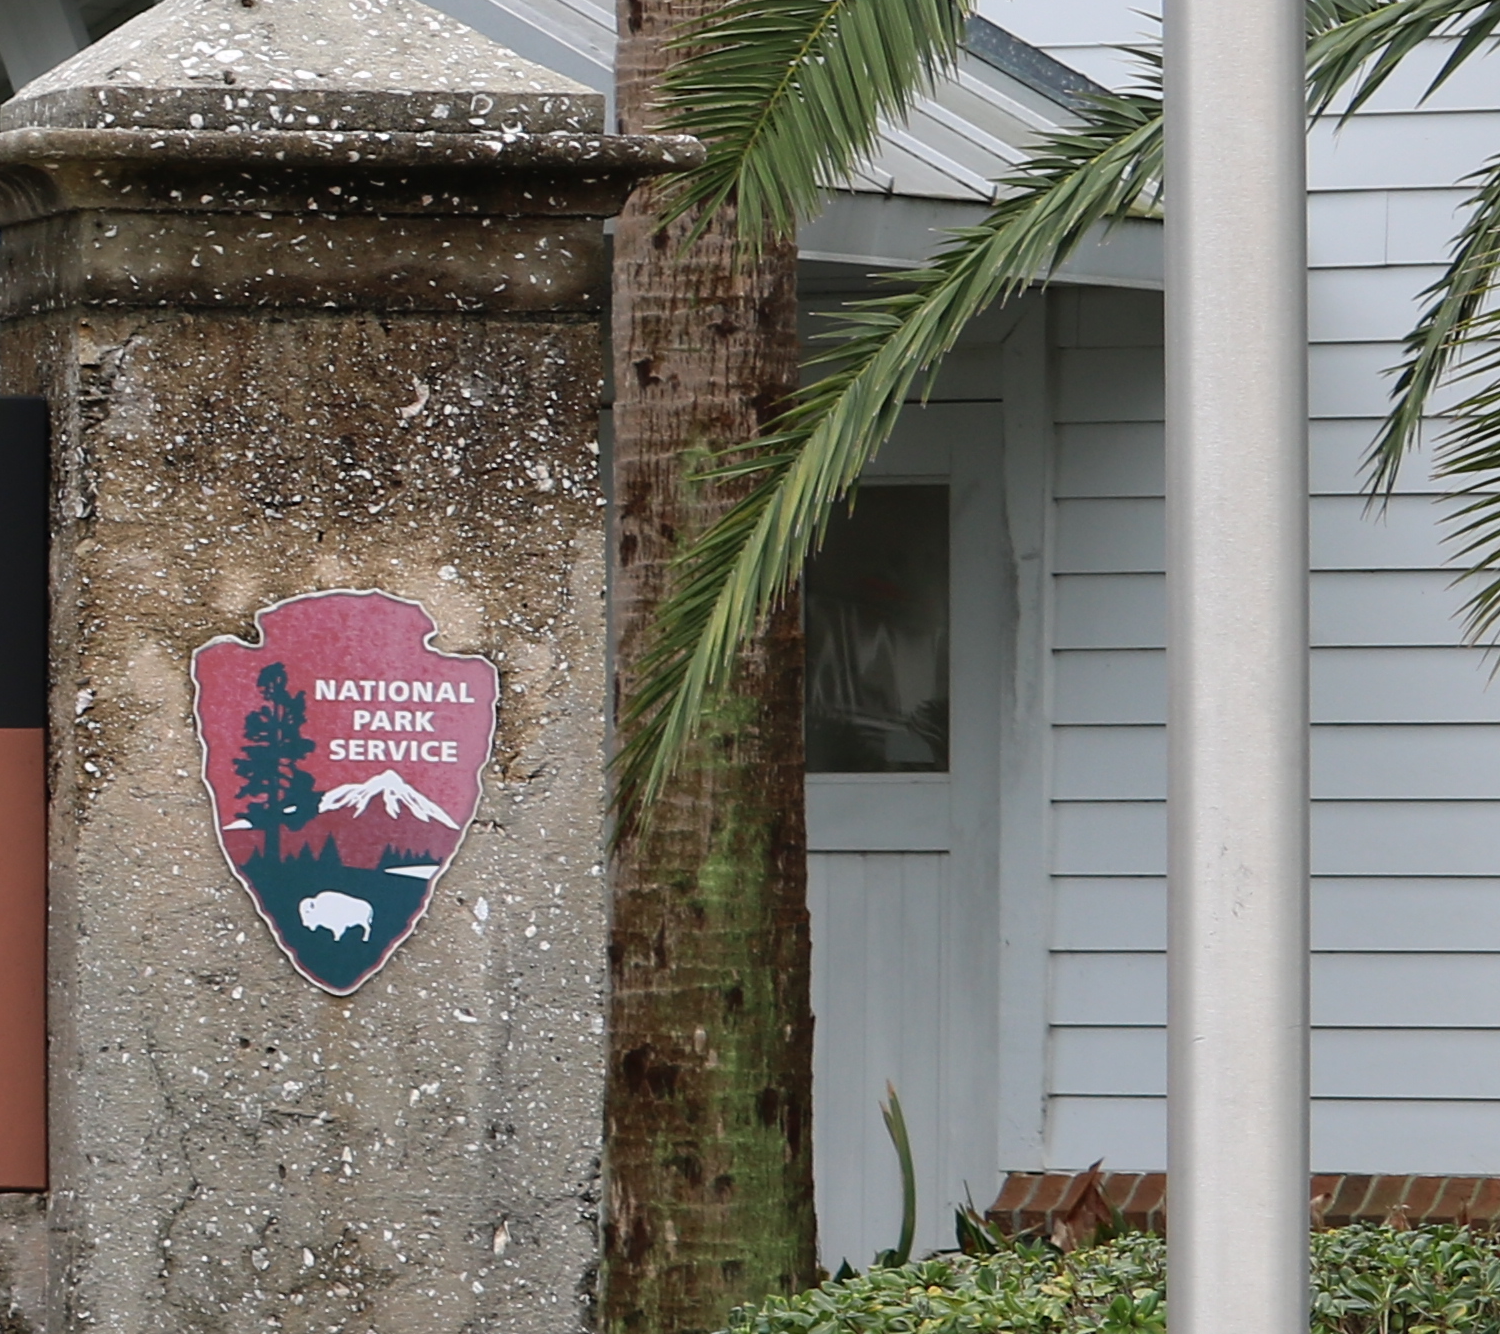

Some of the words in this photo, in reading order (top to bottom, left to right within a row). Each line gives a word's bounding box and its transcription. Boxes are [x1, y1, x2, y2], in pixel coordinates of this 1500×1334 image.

[315, 679, 475, 704] NATIONAL
[353, 710, 435, 733] PARK
[329, 739, 458, 763] SERVICE
